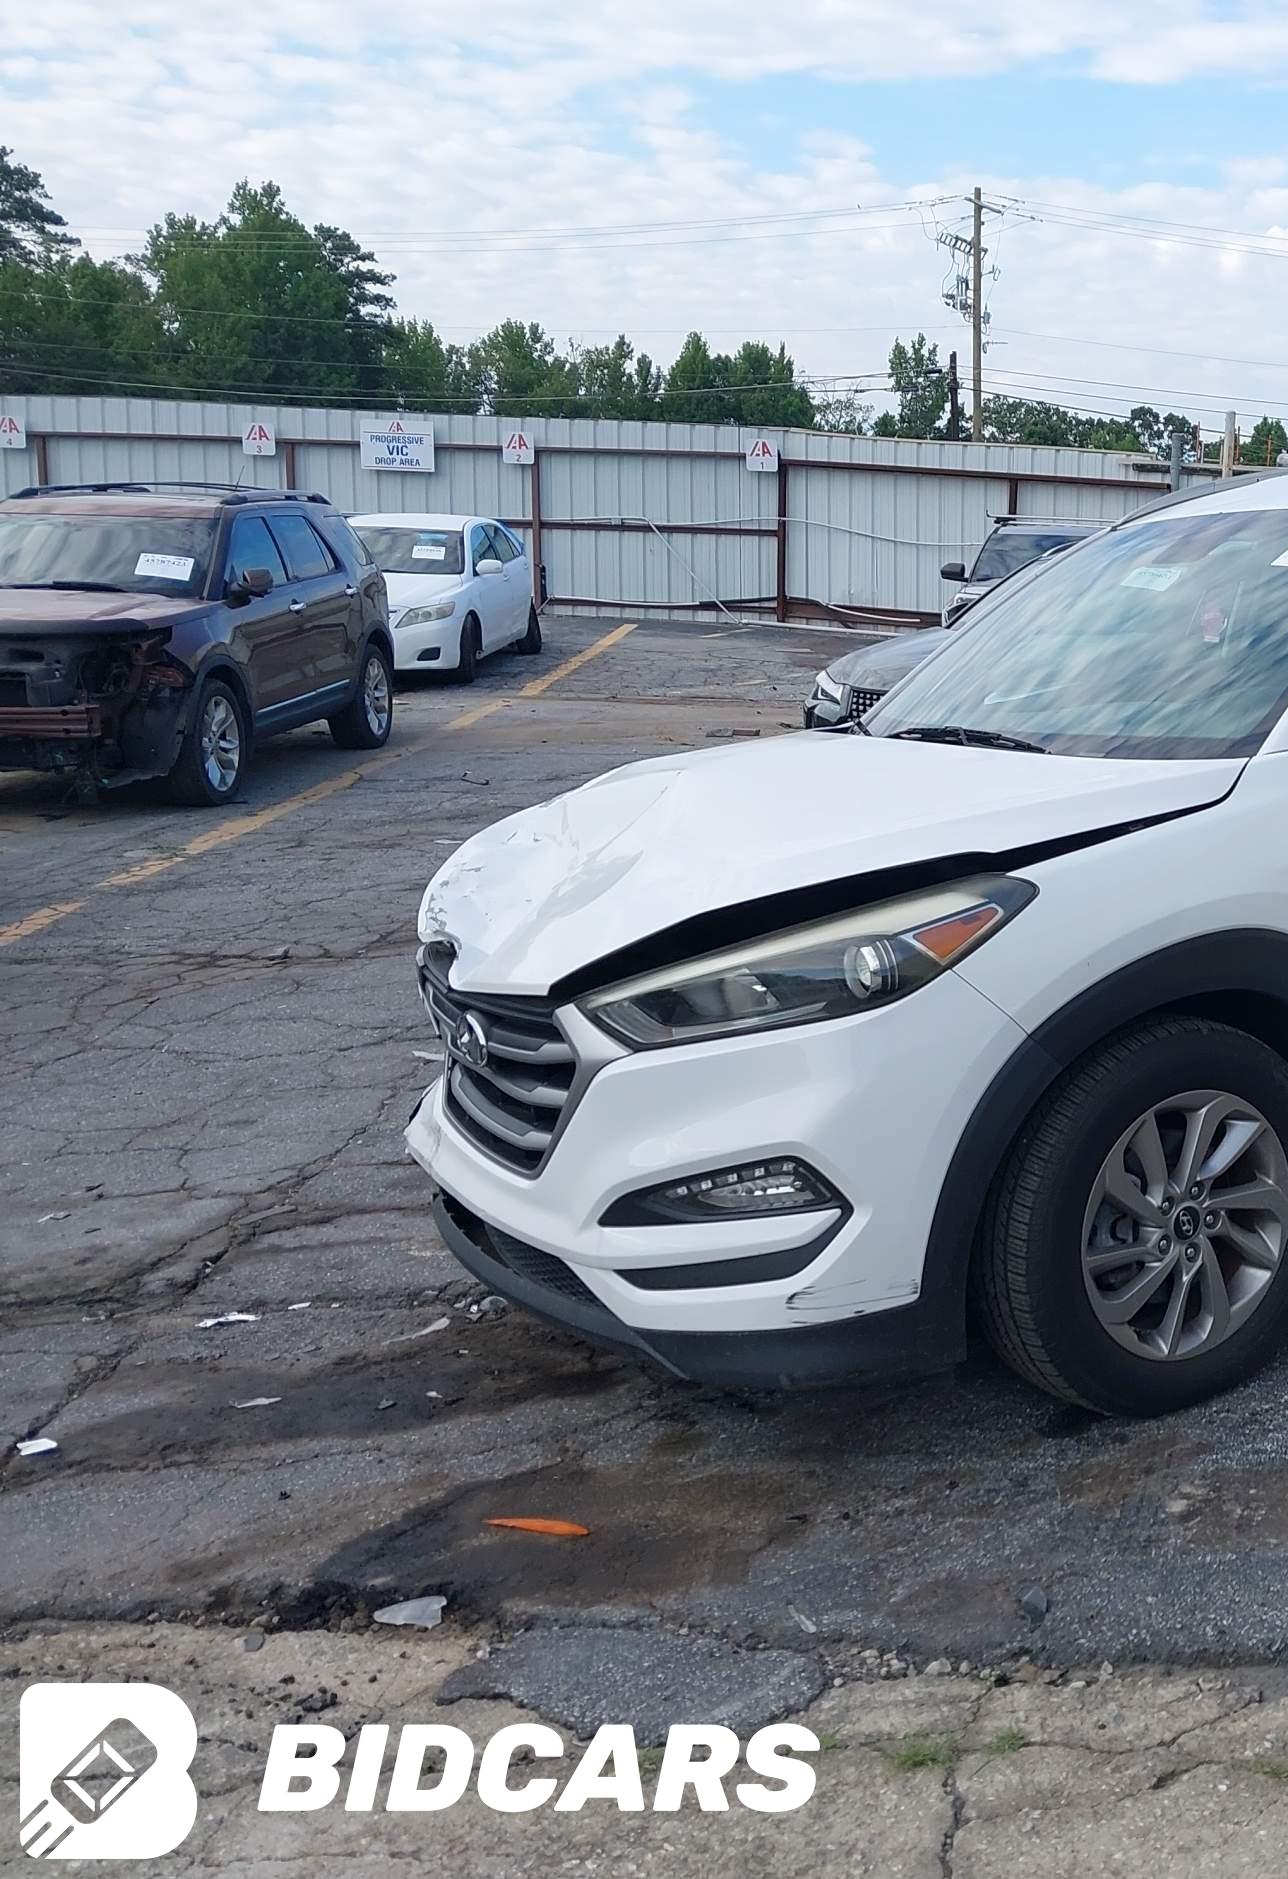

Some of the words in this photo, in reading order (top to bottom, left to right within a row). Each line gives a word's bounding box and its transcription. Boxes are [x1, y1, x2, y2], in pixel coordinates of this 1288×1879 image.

[369, 434, 425, 445] PROGRESSIVE
[256, 444, 263, 454] 3
[386, 445, 409, 456] VIC
[374, 456, 397, 465] DROP
[399, 458, 421, 467] AREA
[515, 454, 522, 462] 2
